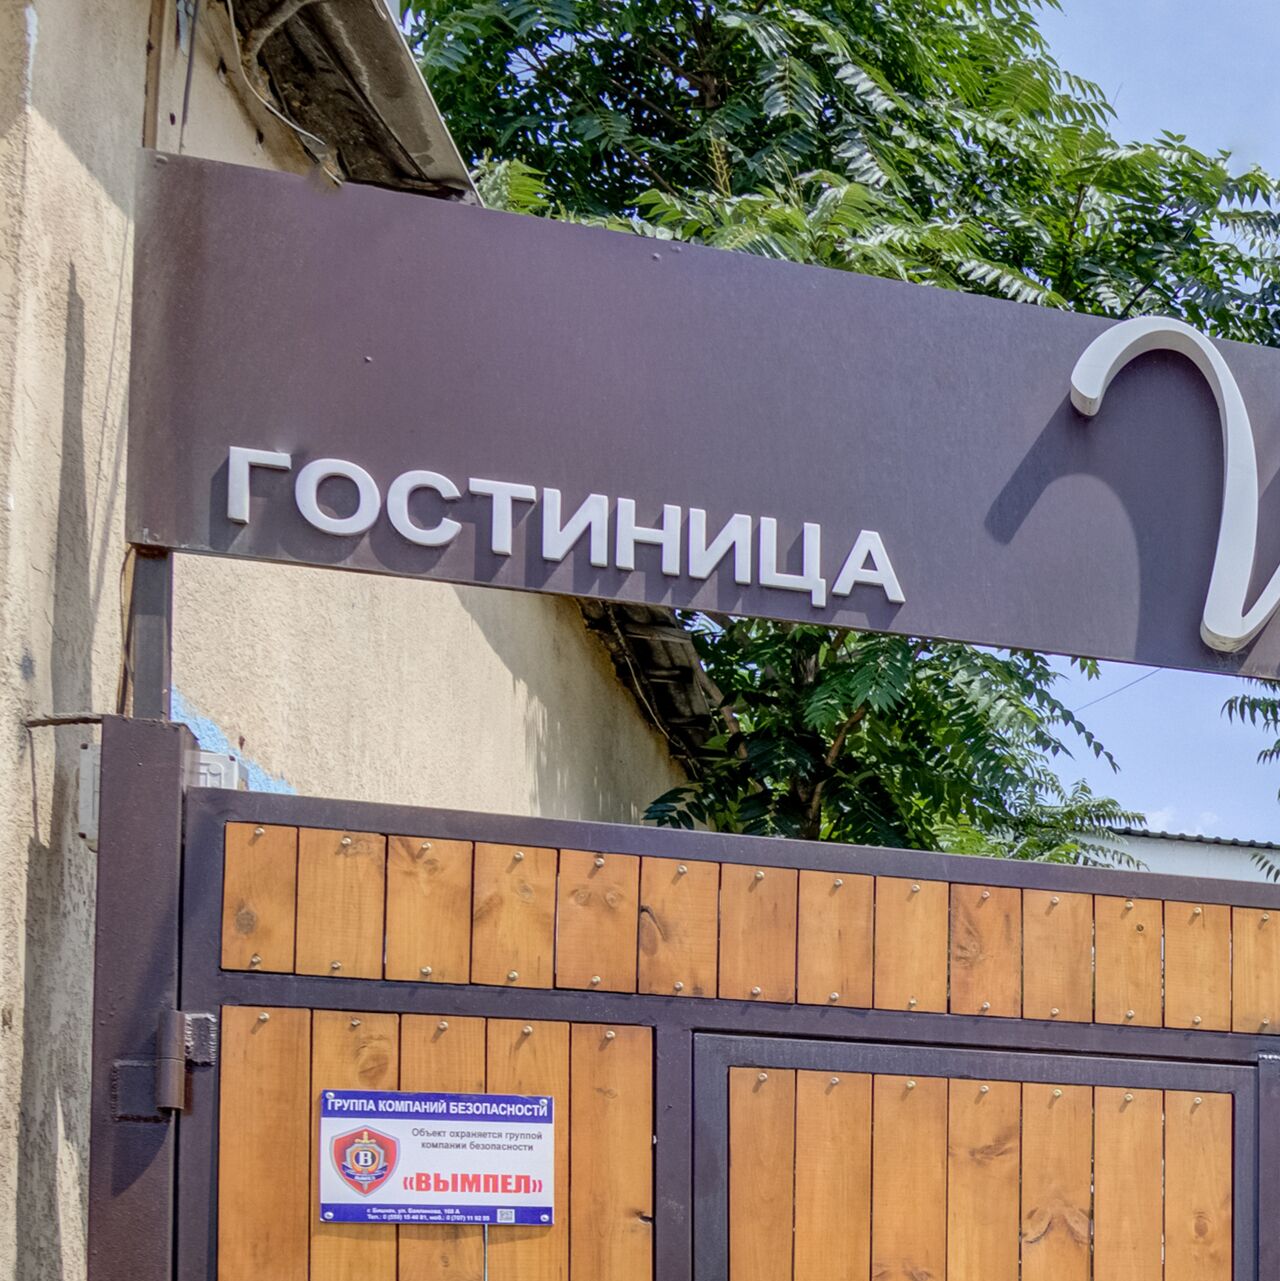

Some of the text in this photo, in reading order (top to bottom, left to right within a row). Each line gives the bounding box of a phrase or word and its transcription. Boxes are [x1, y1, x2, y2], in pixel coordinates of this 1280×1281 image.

[226, 446, 906, 608] ГОСТИНИЦА
[327, 1099, 548, 1117] ГРУППА КОМПАНИЙ БЕЗОПАСНОСТИ
[411, 1128, 543, 1141] Объект охраняется группой
[421, 1141, 534, 1151] компании безопасности
[403, 1172, 543, 1194] «ВЫМПЕЛ»
